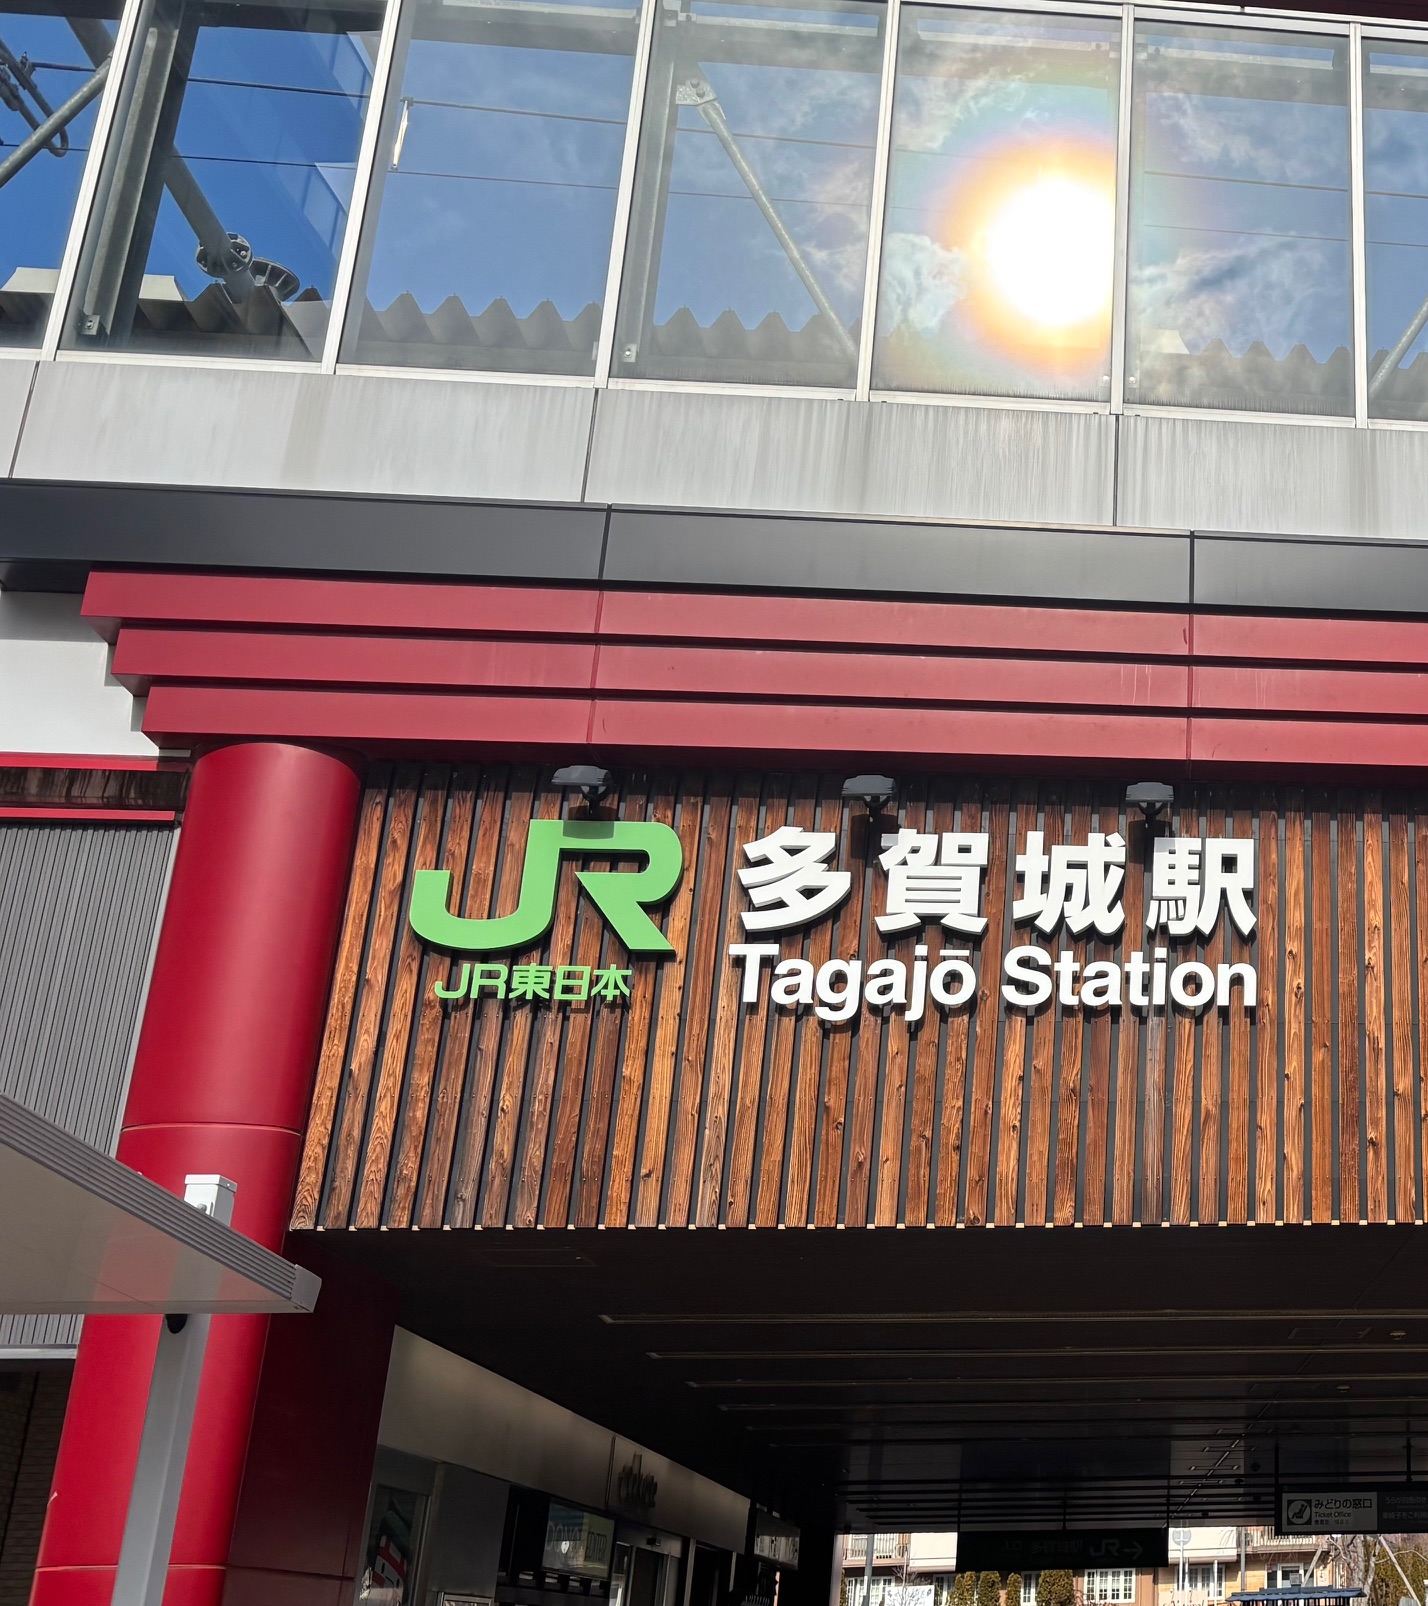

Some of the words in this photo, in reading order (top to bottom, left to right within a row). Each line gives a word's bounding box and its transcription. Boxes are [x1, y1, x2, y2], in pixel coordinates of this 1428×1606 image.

[410, 819, 683, 952] JR
[737, 827, 1258, 936] 多賀城駅
[435, 963, 632, 1001] JR東日本
[729, 943, 977, 1021] Tagajō
[1002, 946, 1258, 1008] Station
[1314, 1498, 1372, 1509] みどりの窓口
[1089, 1538, 1120, 1556] JR
